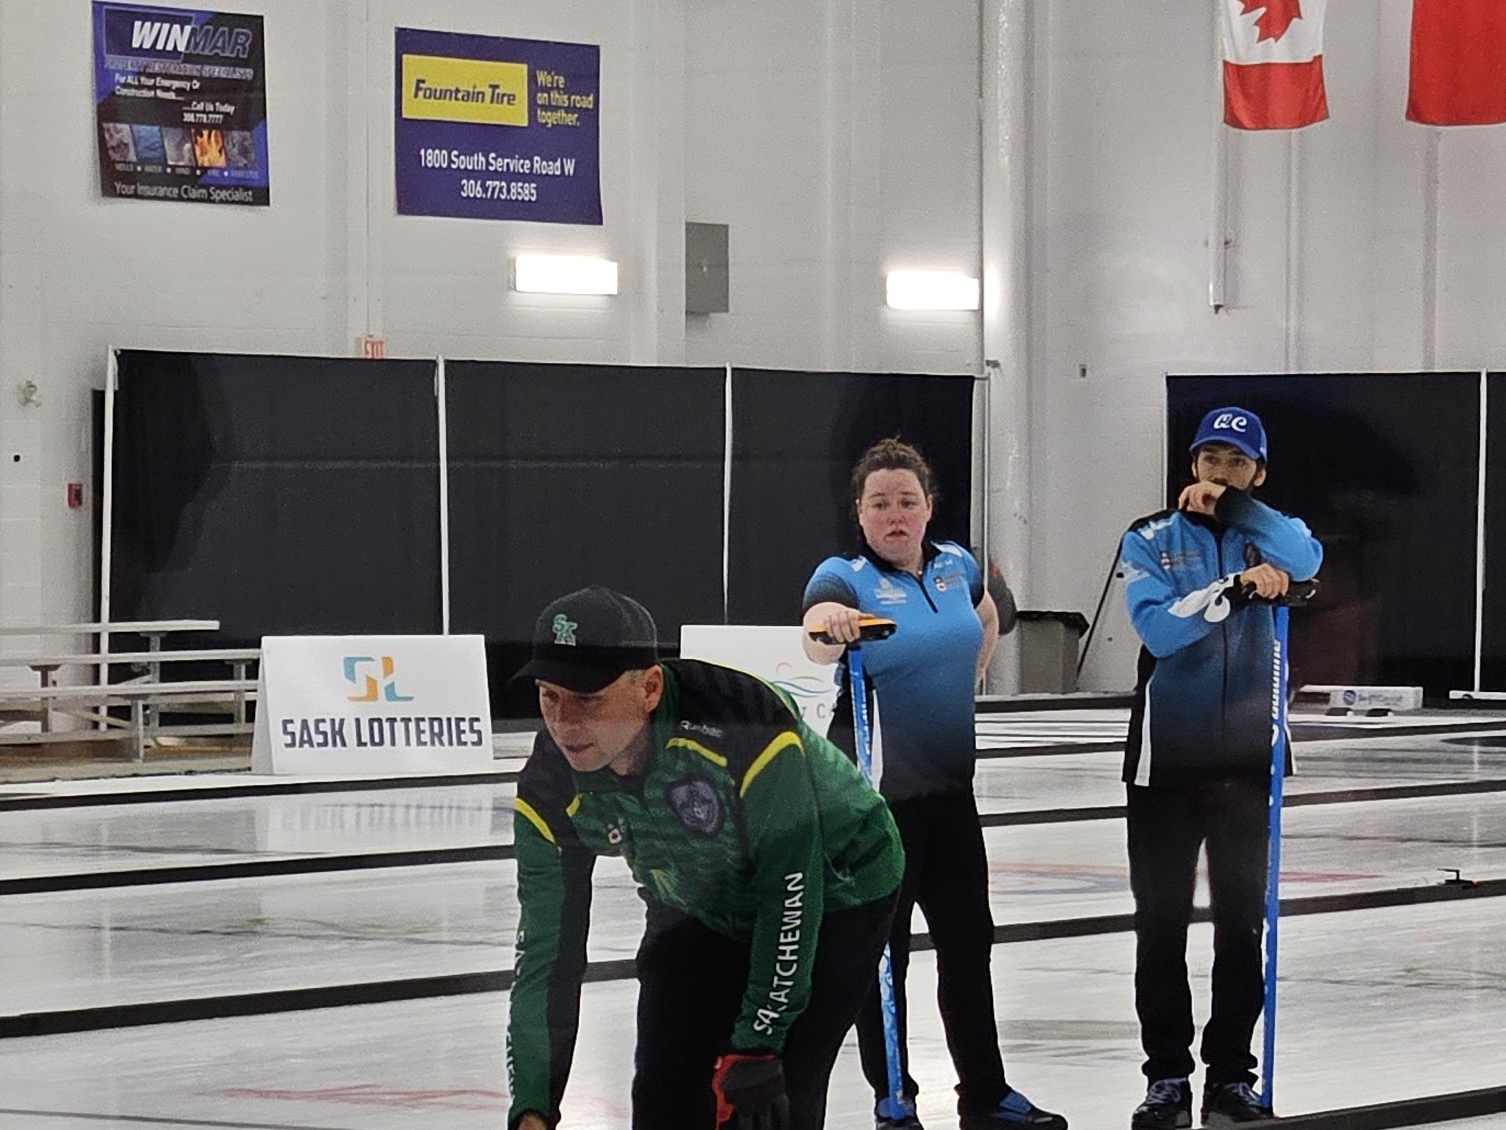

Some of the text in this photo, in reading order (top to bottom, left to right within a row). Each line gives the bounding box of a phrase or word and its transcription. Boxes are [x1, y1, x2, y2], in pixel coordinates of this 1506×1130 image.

[131, 20, 252, 58] WINMAR
[536, 70, 565, 88] We're
[413, 78, 517, 106] Fountain Tire
[536, 90, 594, 109] on this road
[537, 108, 580, 128] together.
[420, 148, 575, 176] 1800 South Service Road W
[114, 181, 135, 195] Your
[180, 185, 208, 199] Claim
[460, 179, 537, 202] 306.773.8585
[281, 716, 483, 749] SASK LOTTERIES
